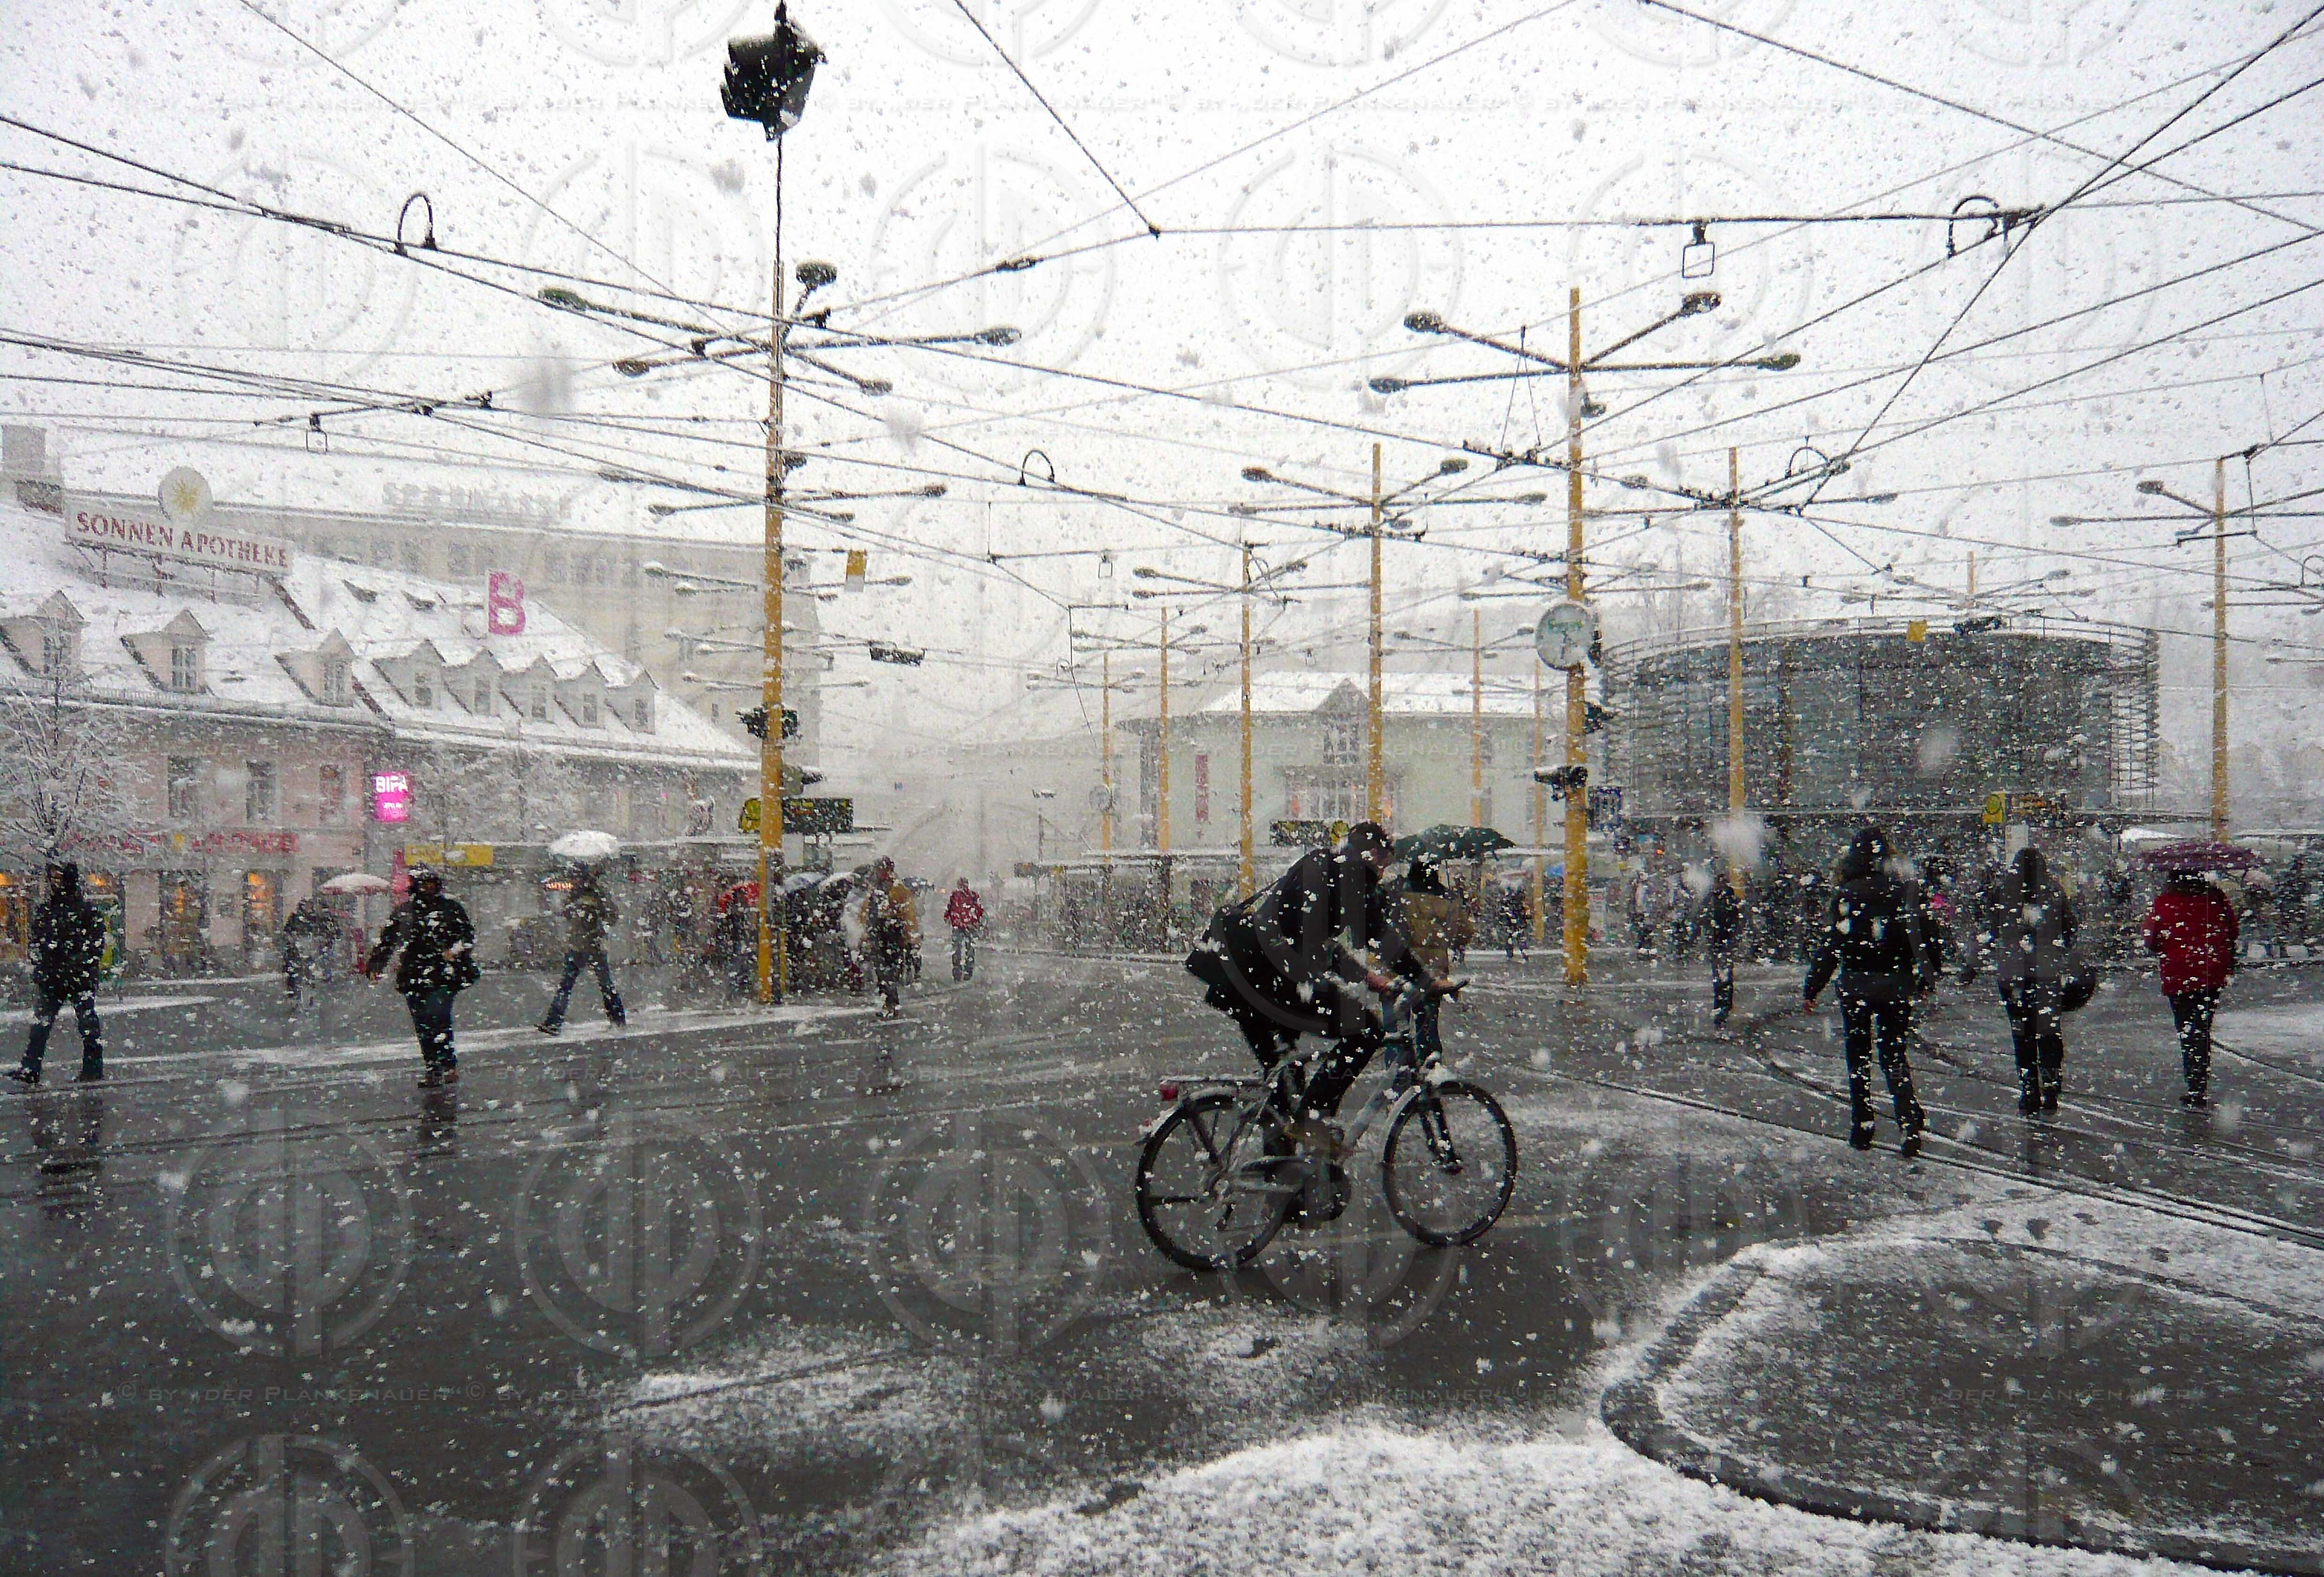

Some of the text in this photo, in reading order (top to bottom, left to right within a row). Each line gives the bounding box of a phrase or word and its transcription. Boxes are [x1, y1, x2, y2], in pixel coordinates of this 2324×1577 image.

[77, 512, 288, 568] SONNEN APOTHEKE
[489, 572, 526, 636] B
